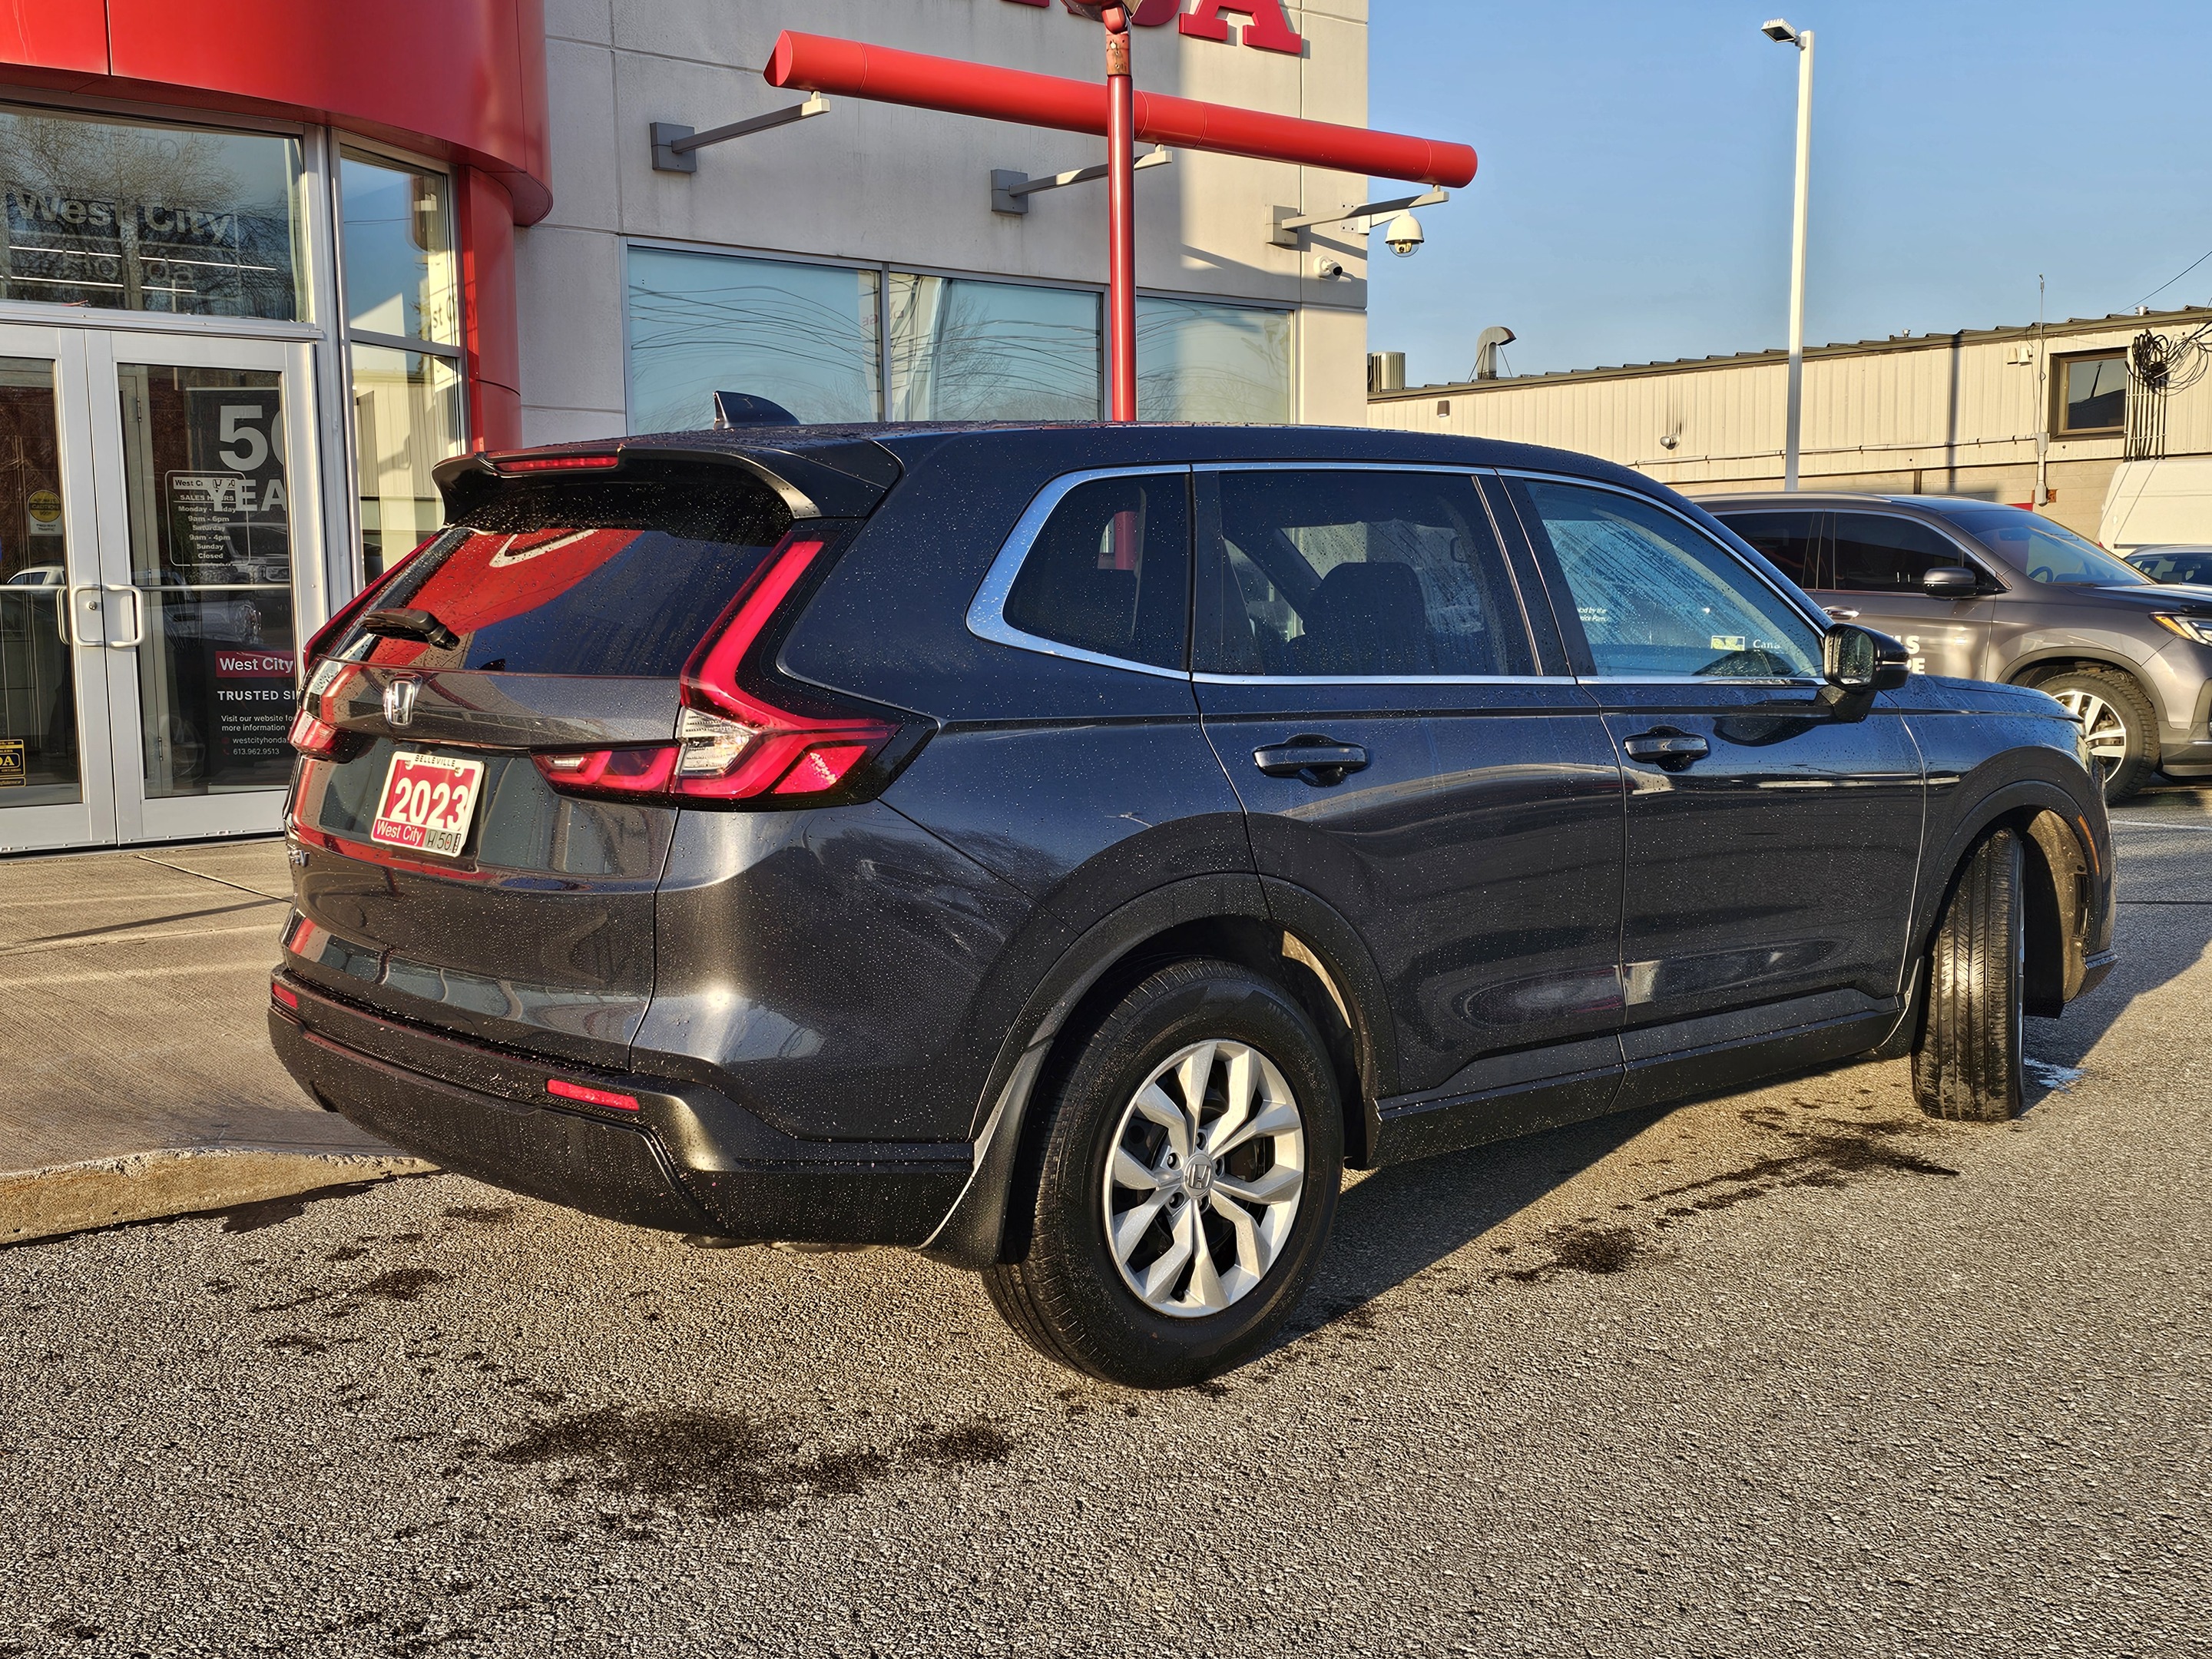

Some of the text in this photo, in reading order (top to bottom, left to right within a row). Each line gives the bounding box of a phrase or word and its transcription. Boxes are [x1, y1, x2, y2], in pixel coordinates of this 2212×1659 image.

[15, 194, 230, 244] West City
[63, 243, 194, 283] Hoda
[178, 505, 207, 514] Monday
[219, 657, 294, 674] West City
[217, 690, 279, 700] TRUSTED
[415, 754, 456, 767] BELLEVILLE
[389, 777, 469, 831] 2023
[376, 820, 402, 839] West
[402, 825, 422, 846] City
